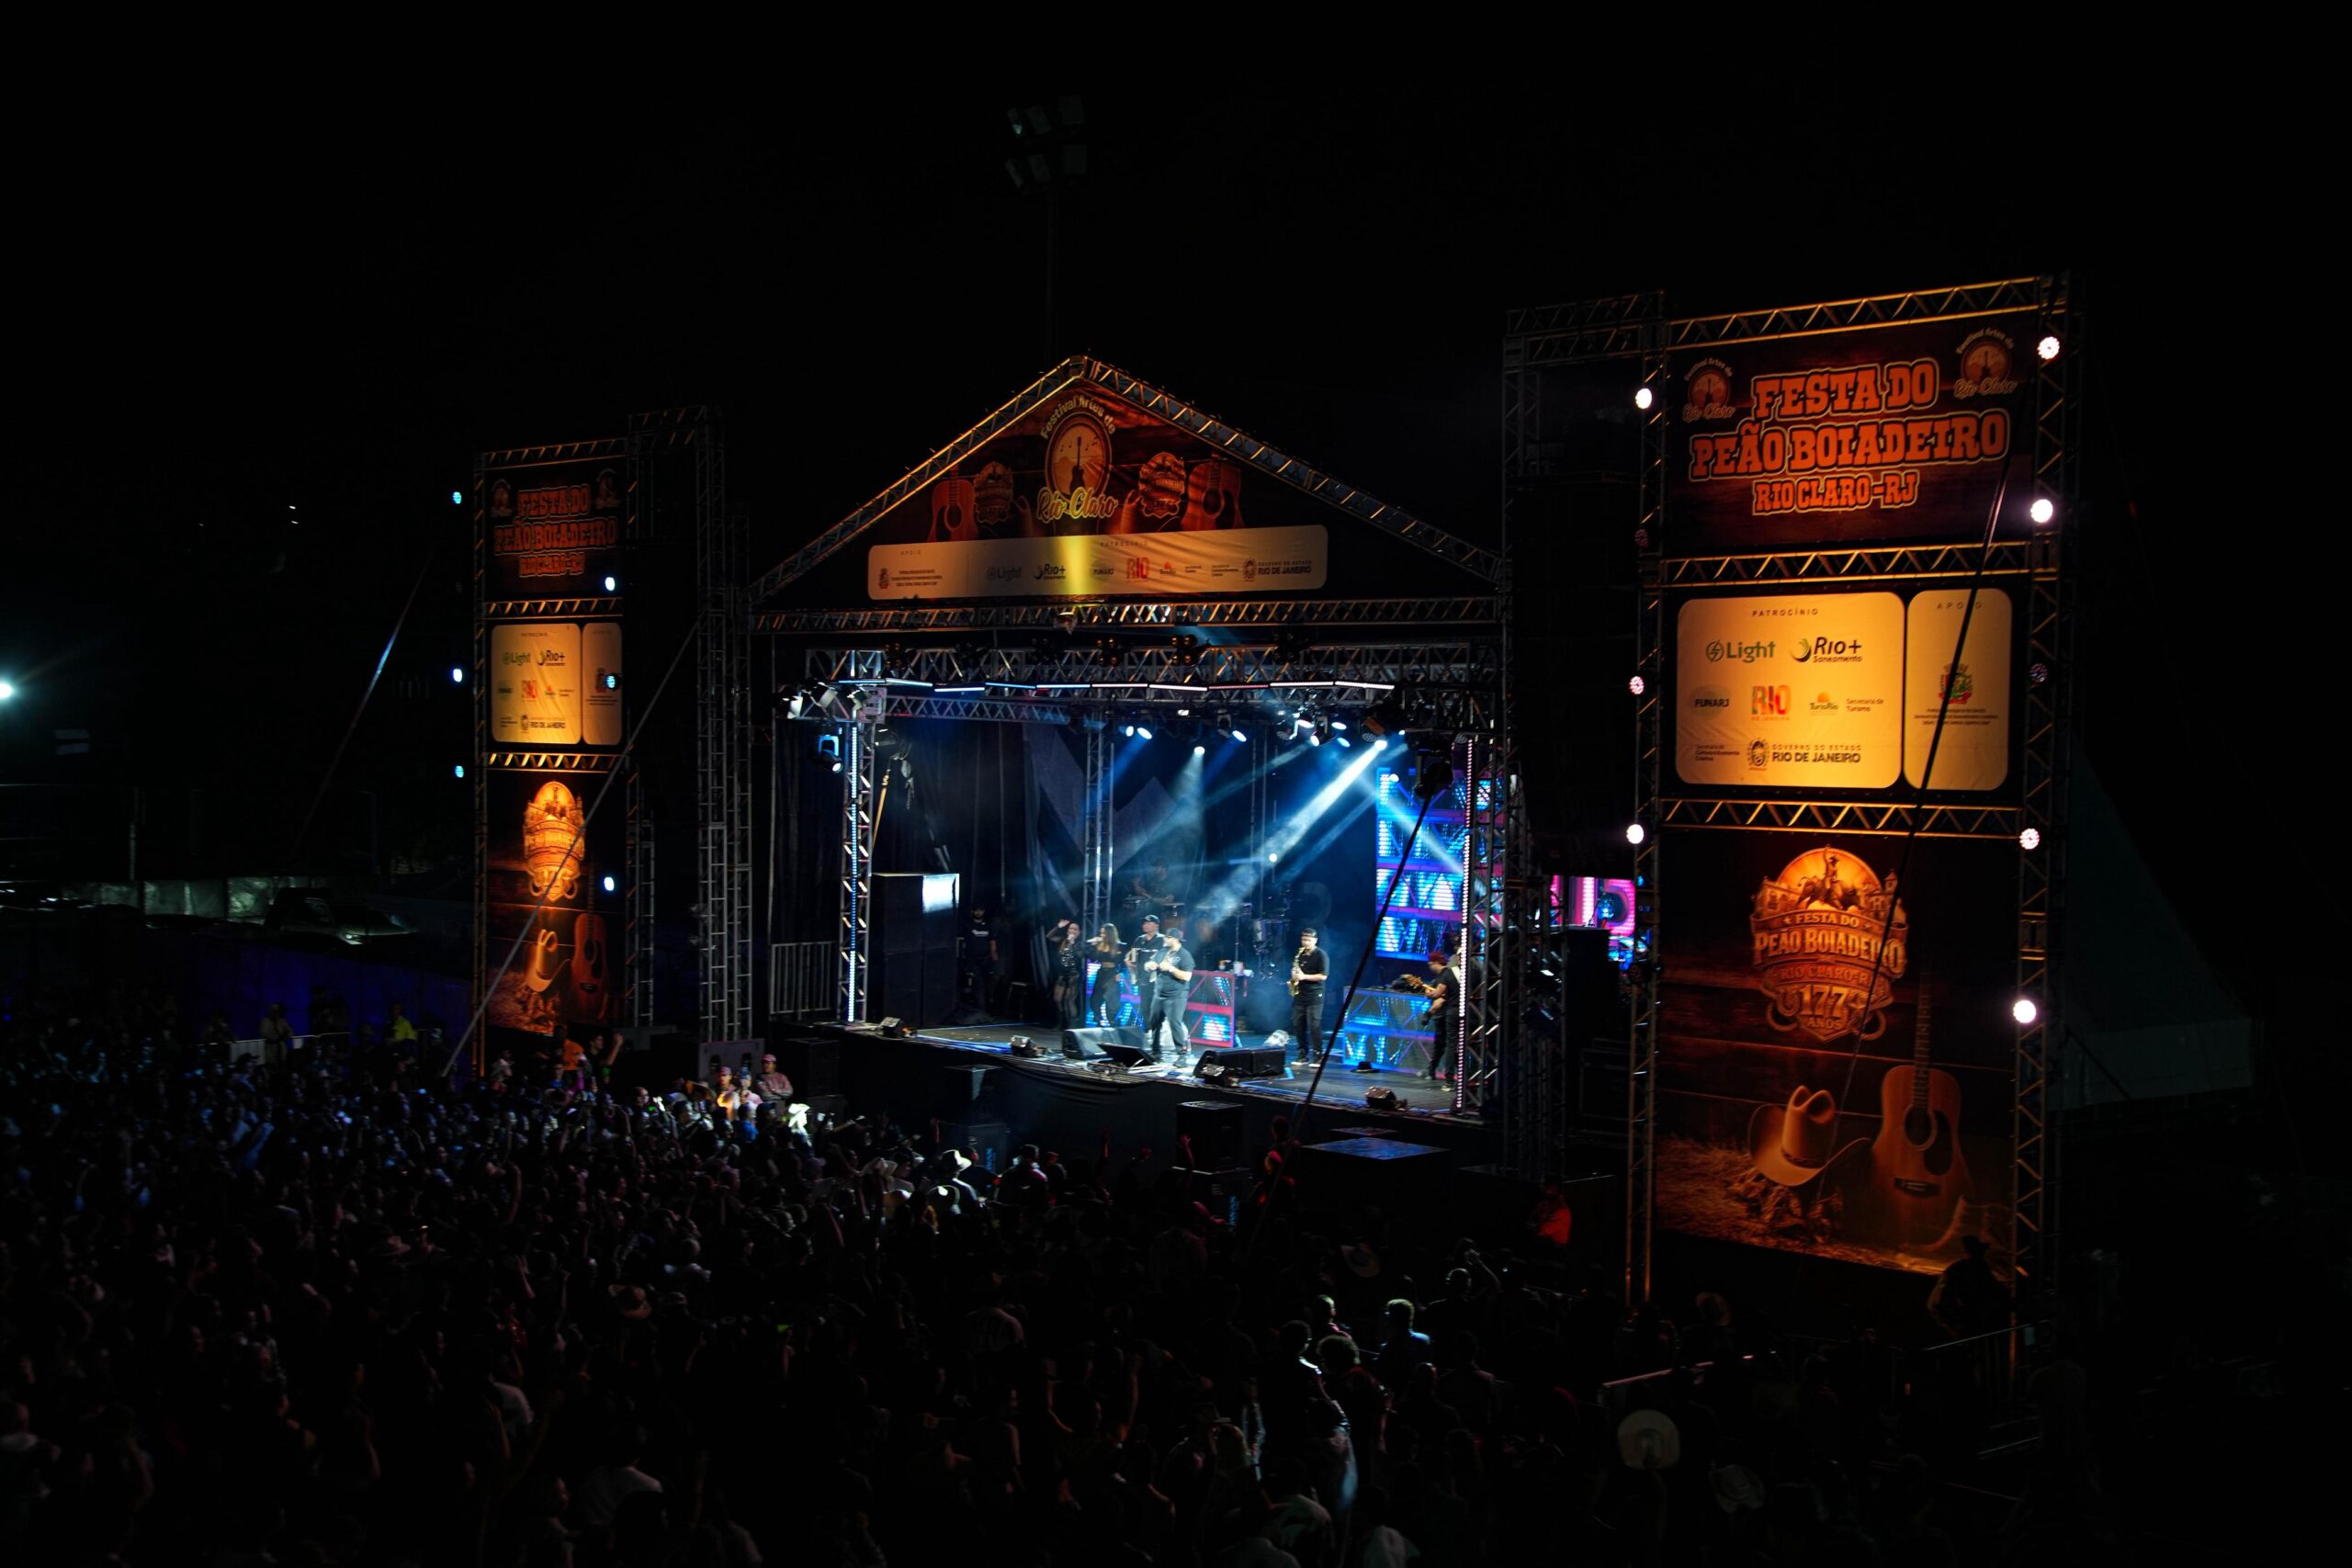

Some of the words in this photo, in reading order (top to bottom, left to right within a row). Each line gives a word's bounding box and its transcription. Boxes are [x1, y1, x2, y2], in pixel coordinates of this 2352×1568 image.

[1755, 368, 1881, 419] FESTA
[1886, 361, 1937, 408] DO
[1040, 395, 1076, 440] Festival
[1692, 422, 1787, 479] PEÃO
[1790, 412, 2007, 472] BOIADEIRO
[1068, 486, 1119, 520] Claro
[1755, 480, 1796, 513] RIO
[1258, 567, 1271, 576] RIO
[1283, 566, 1313, 575] JANEIRO
[1751, 607, 1818, 617] PATROCÍNIO
[1936, 602, 1983, 610] APOO
[1726, 641, 1776, 663] Light
[1752, 685, 1791, 715] RIO
[1772, 751, 1792, 762] RIO
[1794, 751, 1809, 762] DE
[1811, 752, 1862, 763] JANEIRO
[1794, 912, 1838, 925] FESTA
[1841, 915, 1860, 928] DO
[1799, 985, 1849, 1018] 177
